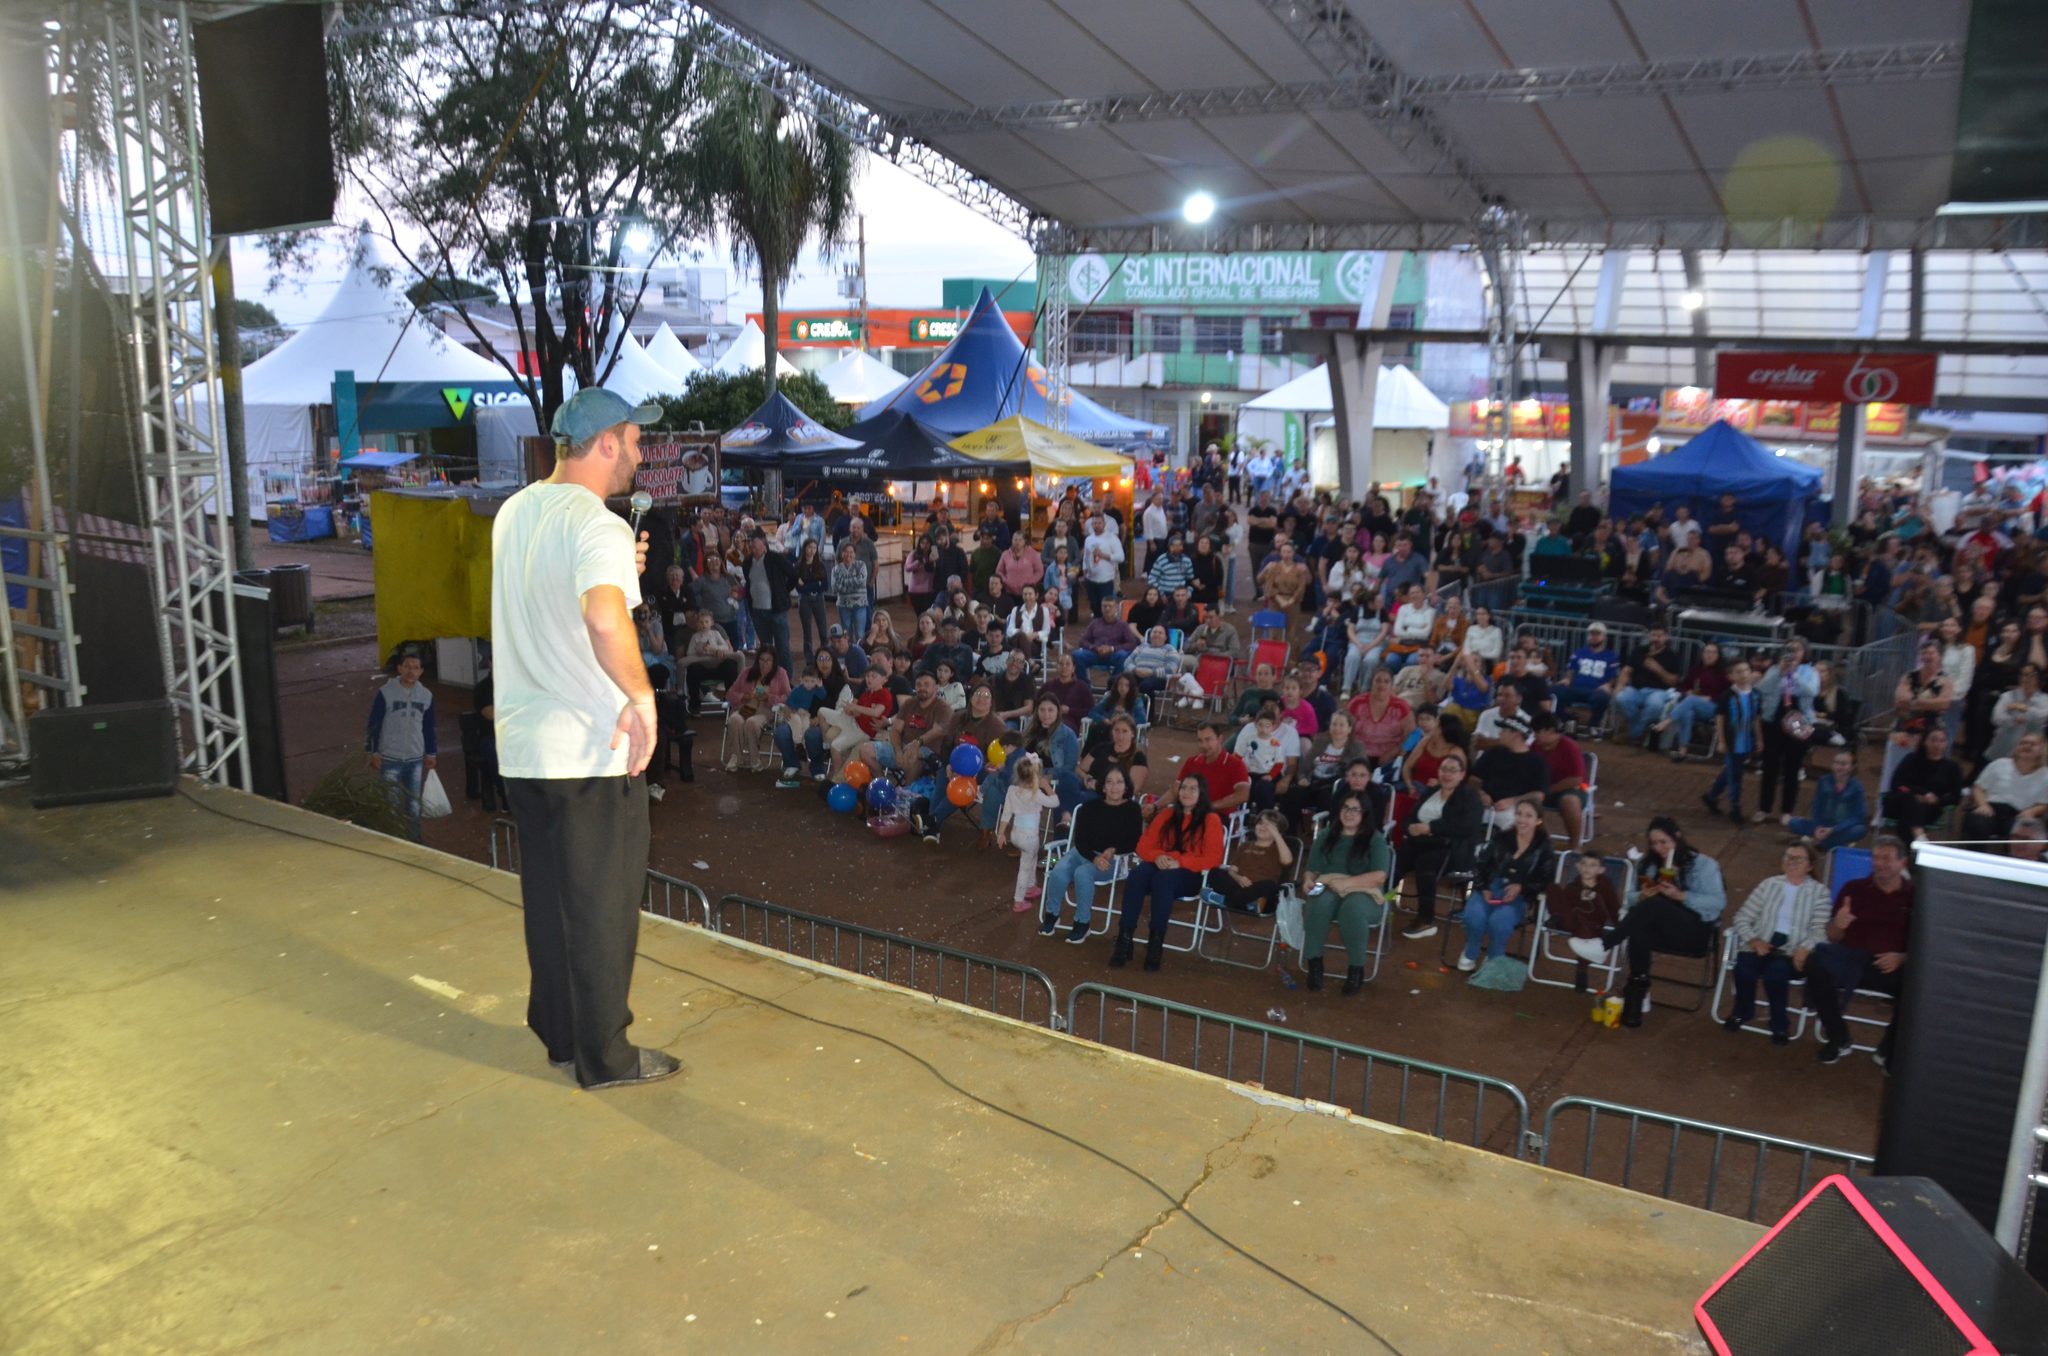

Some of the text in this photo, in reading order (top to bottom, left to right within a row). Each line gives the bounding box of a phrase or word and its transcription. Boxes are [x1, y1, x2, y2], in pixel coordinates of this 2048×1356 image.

[1122, 255, 1320, 286] SC INTERNACIONAL
[1126, 286, 1189, 298] CONSULADO
[1748, 363, 1819, 385] creluz
[635, 466, 685, 487] CHOCOLATE
